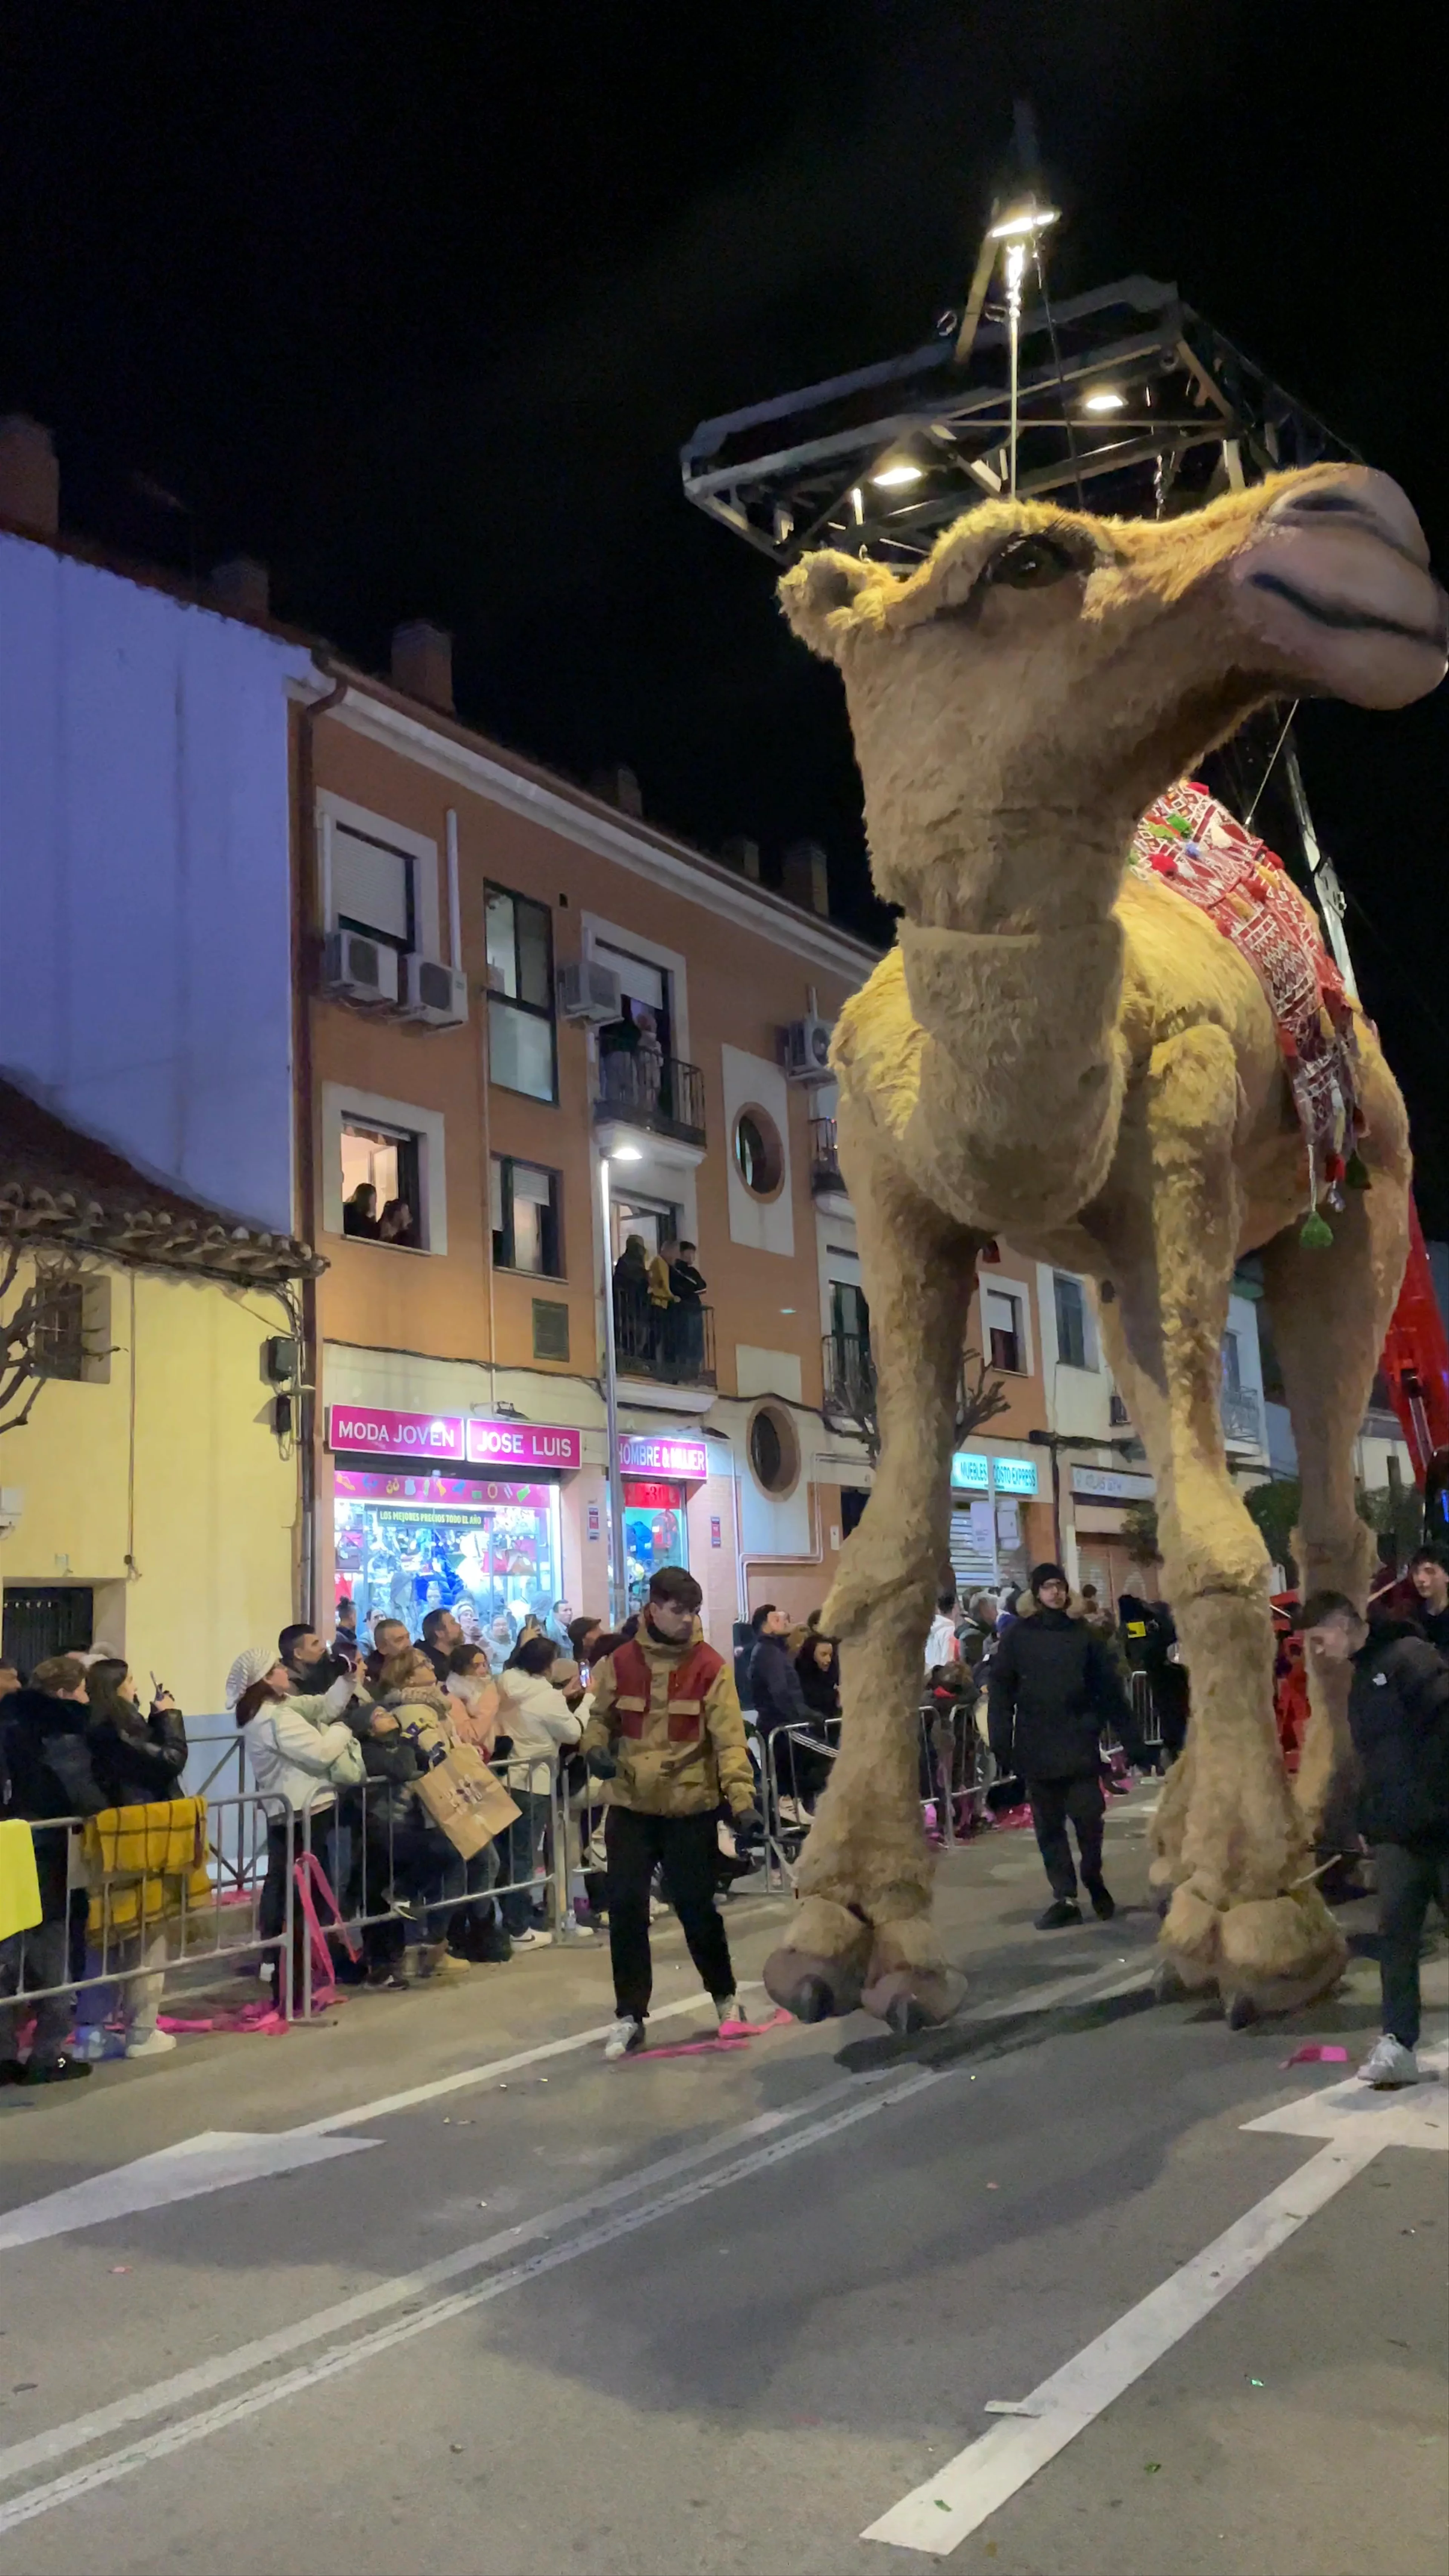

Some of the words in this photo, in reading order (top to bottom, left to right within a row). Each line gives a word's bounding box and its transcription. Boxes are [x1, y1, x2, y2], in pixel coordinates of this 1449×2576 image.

[338, 1420, 389, 1442] MODA
[393, 1424, 454, 1448] JOVEN
[476, 1431, 524, 1454] JOSE
[532, 1435, 572, 1457] LUIS
[662, 1446, 670, 1468] &
[960, 1462, 987, 1481] MUEBLES
[1012, 1467, 1035, 1487] EXPRESS
[380, 1510, 391, 1520] LOS
[392, 1511, 420, 1523] MEJORES
[420, 1513, 445, 1523] PRECIOS
[446, 1514, 461, 1524] TODO
[461, 1515, 469, 1524] EL
[469, 1514, 481, 1525] AÑO
